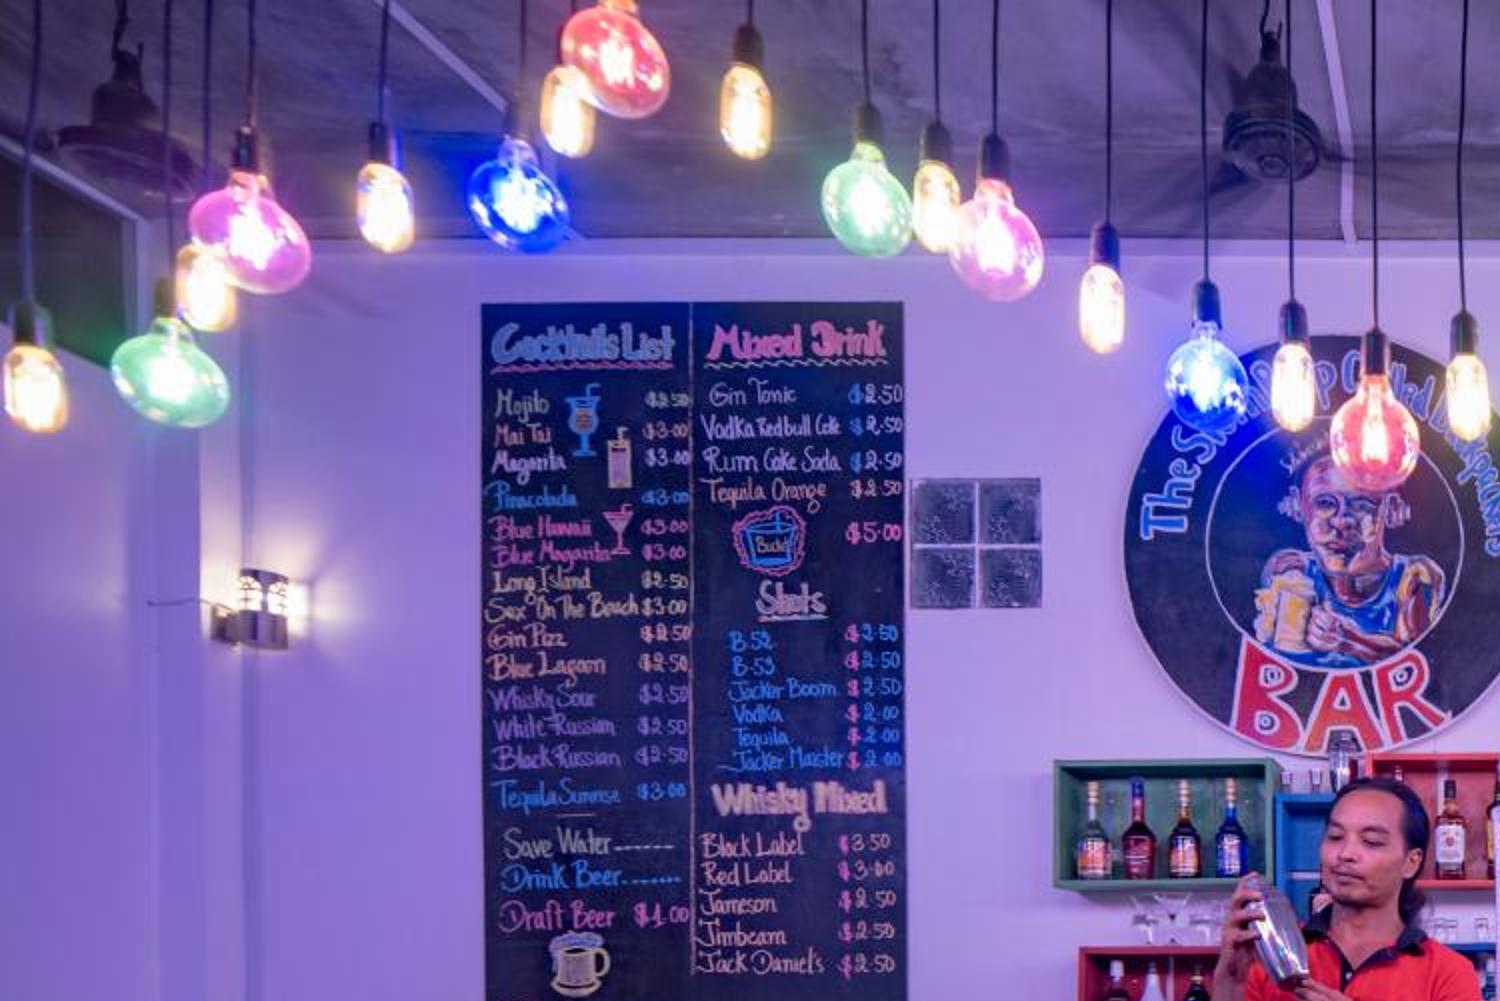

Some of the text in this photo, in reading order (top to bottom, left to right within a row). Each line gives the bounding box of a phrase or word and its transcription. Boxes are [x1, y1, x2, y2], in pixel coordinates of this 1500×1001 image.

[621, 322, 676, 361] List
[704, 319, 888, 361] Mixed Drink
[496, 388, 550, 423] Mojito
[709, 382, 748, 408] Gin
[747, 377, 798, 404] Tonic
[496, 423, 525, 446] Mai
[700, 413, 755, 441] Vodka
[702, 445, 760, 473] Rum
[699, 475, 767, 511] Tequila
[771, 477, 828, 515] Orange
[1141, 458, 1203, 541] The
[488, 515, 534, 541] Blue
[490, 542, 534, 568] Blue
[494, 570, 537, 605] Long
[535, 565, 592, 592] Island
[586, 591, 639, 618] Beach
[1229, 635, 1453, 758] BAR
[711, 781, 812, 833] Whisky
[503, 827, 555, 859] Save
[700, 831, 752, 859] Black
[755, 831, 805, 857] Label
[500, 863, 571, 892] Drink
[702, 860, 742, 886] Red
[743, 859, 794, 885] Label
[498, 899, 566, 933] Draft
[699, 886, 779, 916] Jameson
[696, 948, 750, 974] Jack
